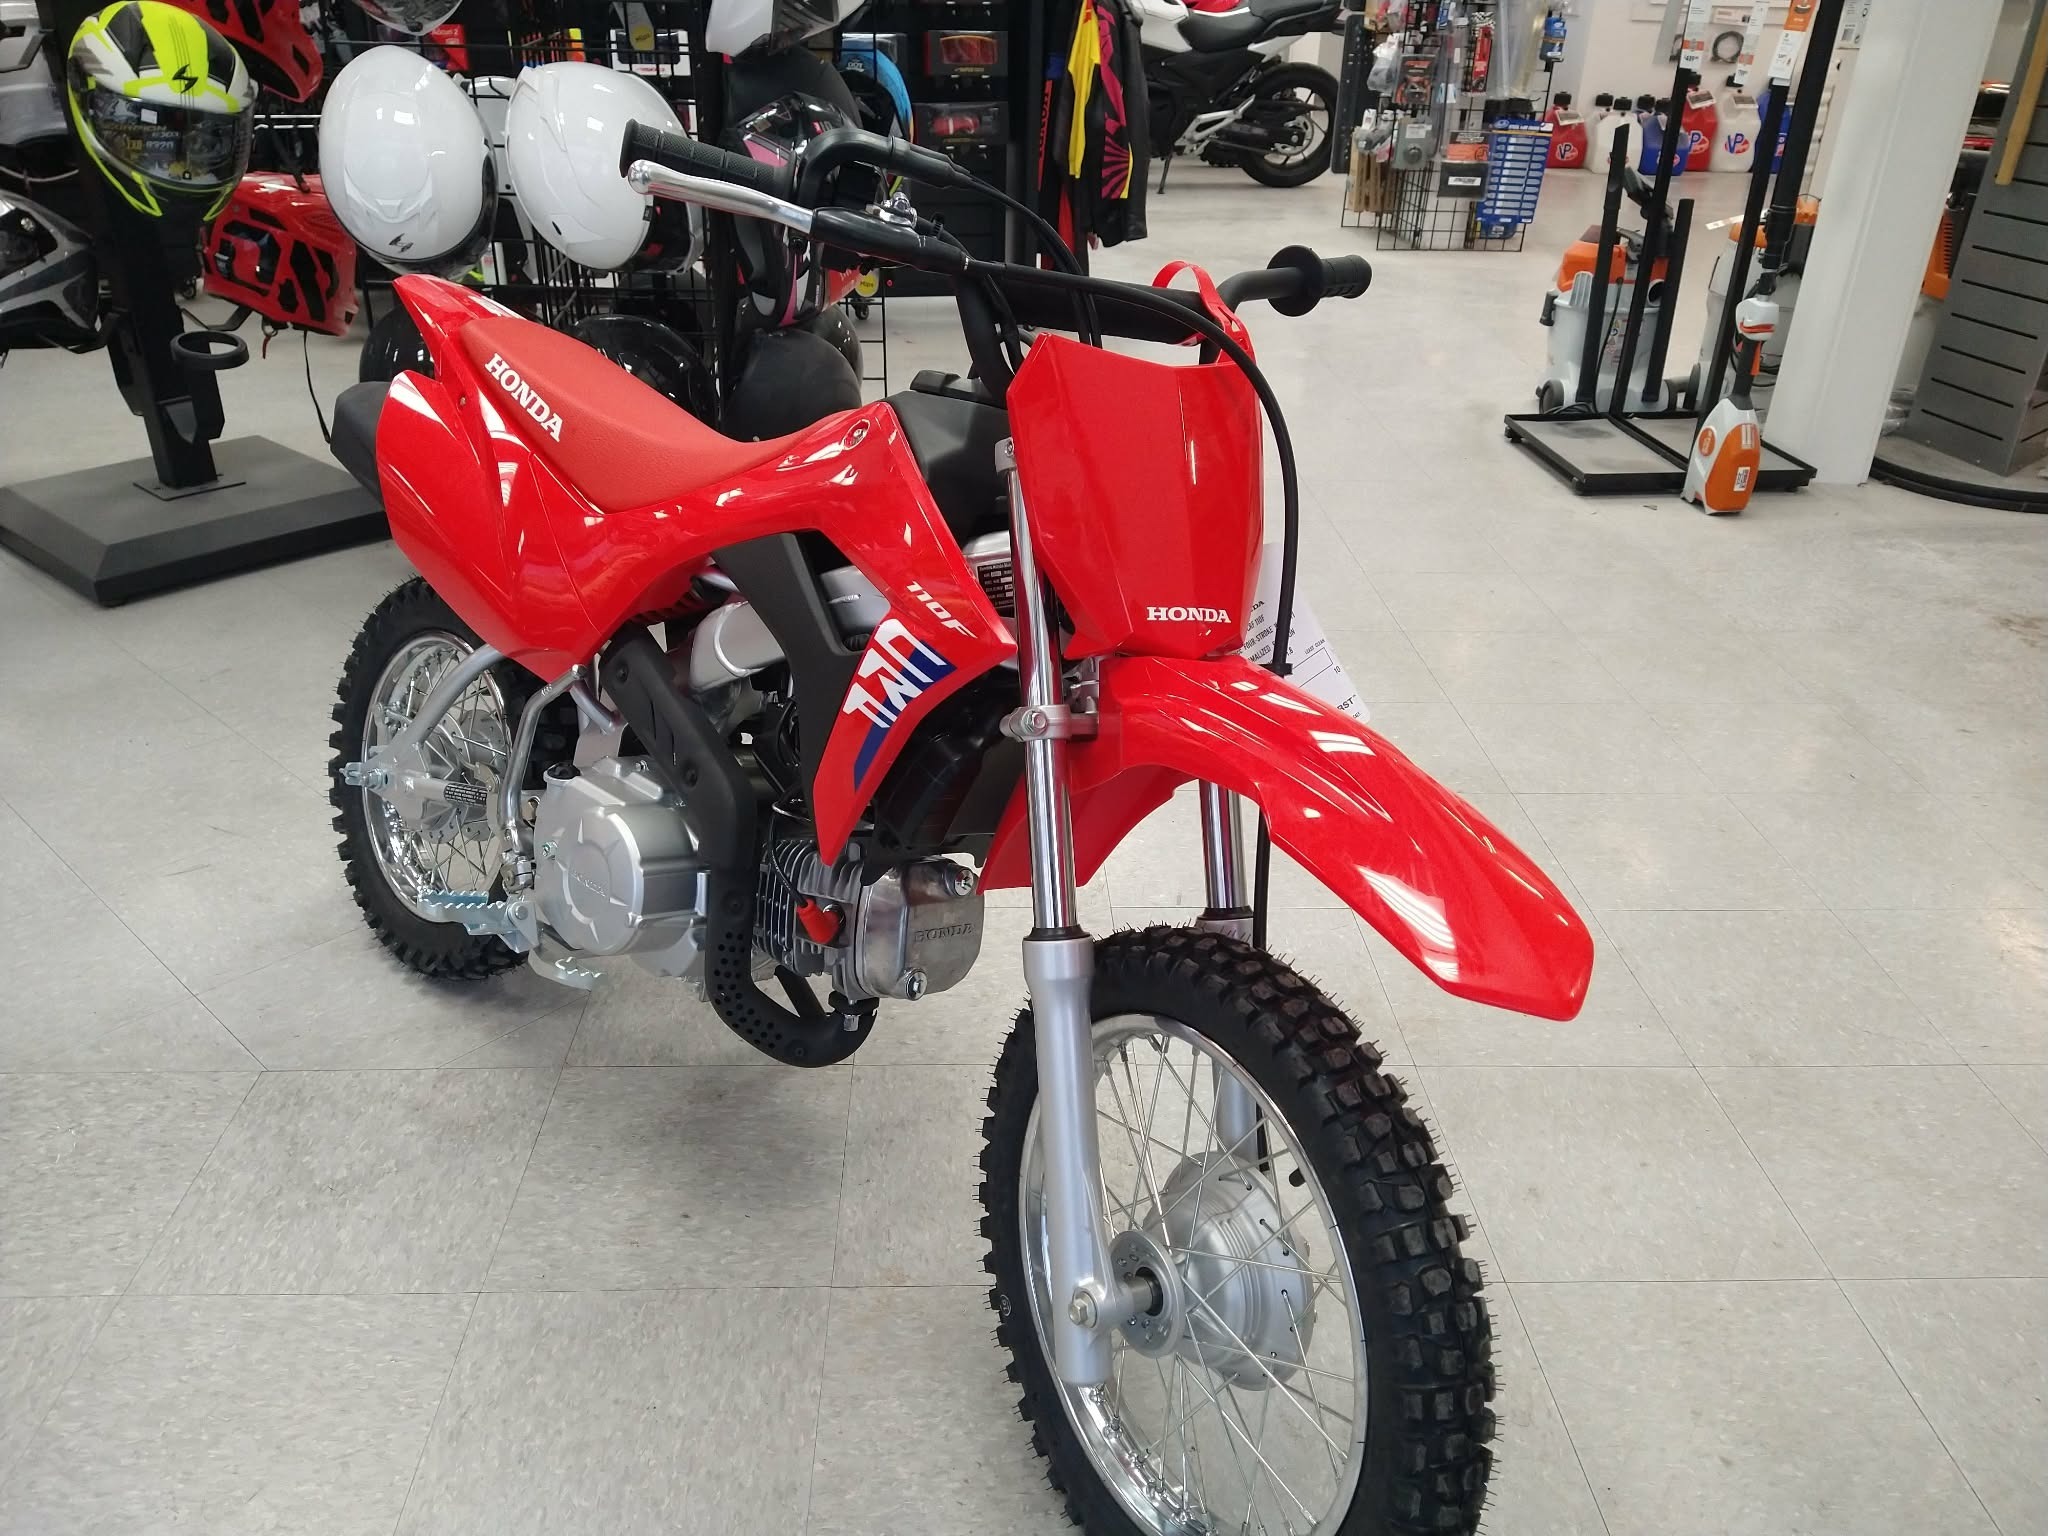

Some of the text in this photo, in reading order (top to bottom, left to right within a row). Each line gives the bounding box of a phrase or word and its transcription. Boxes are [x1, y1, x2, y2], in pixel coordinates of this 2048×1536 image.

[485, 353, 563, 443] HONDA
[906, 581, 978, 639] 110F
[1146, 606, 1232, 624] HONDA
[914, 922, 974, 944] HONDA
